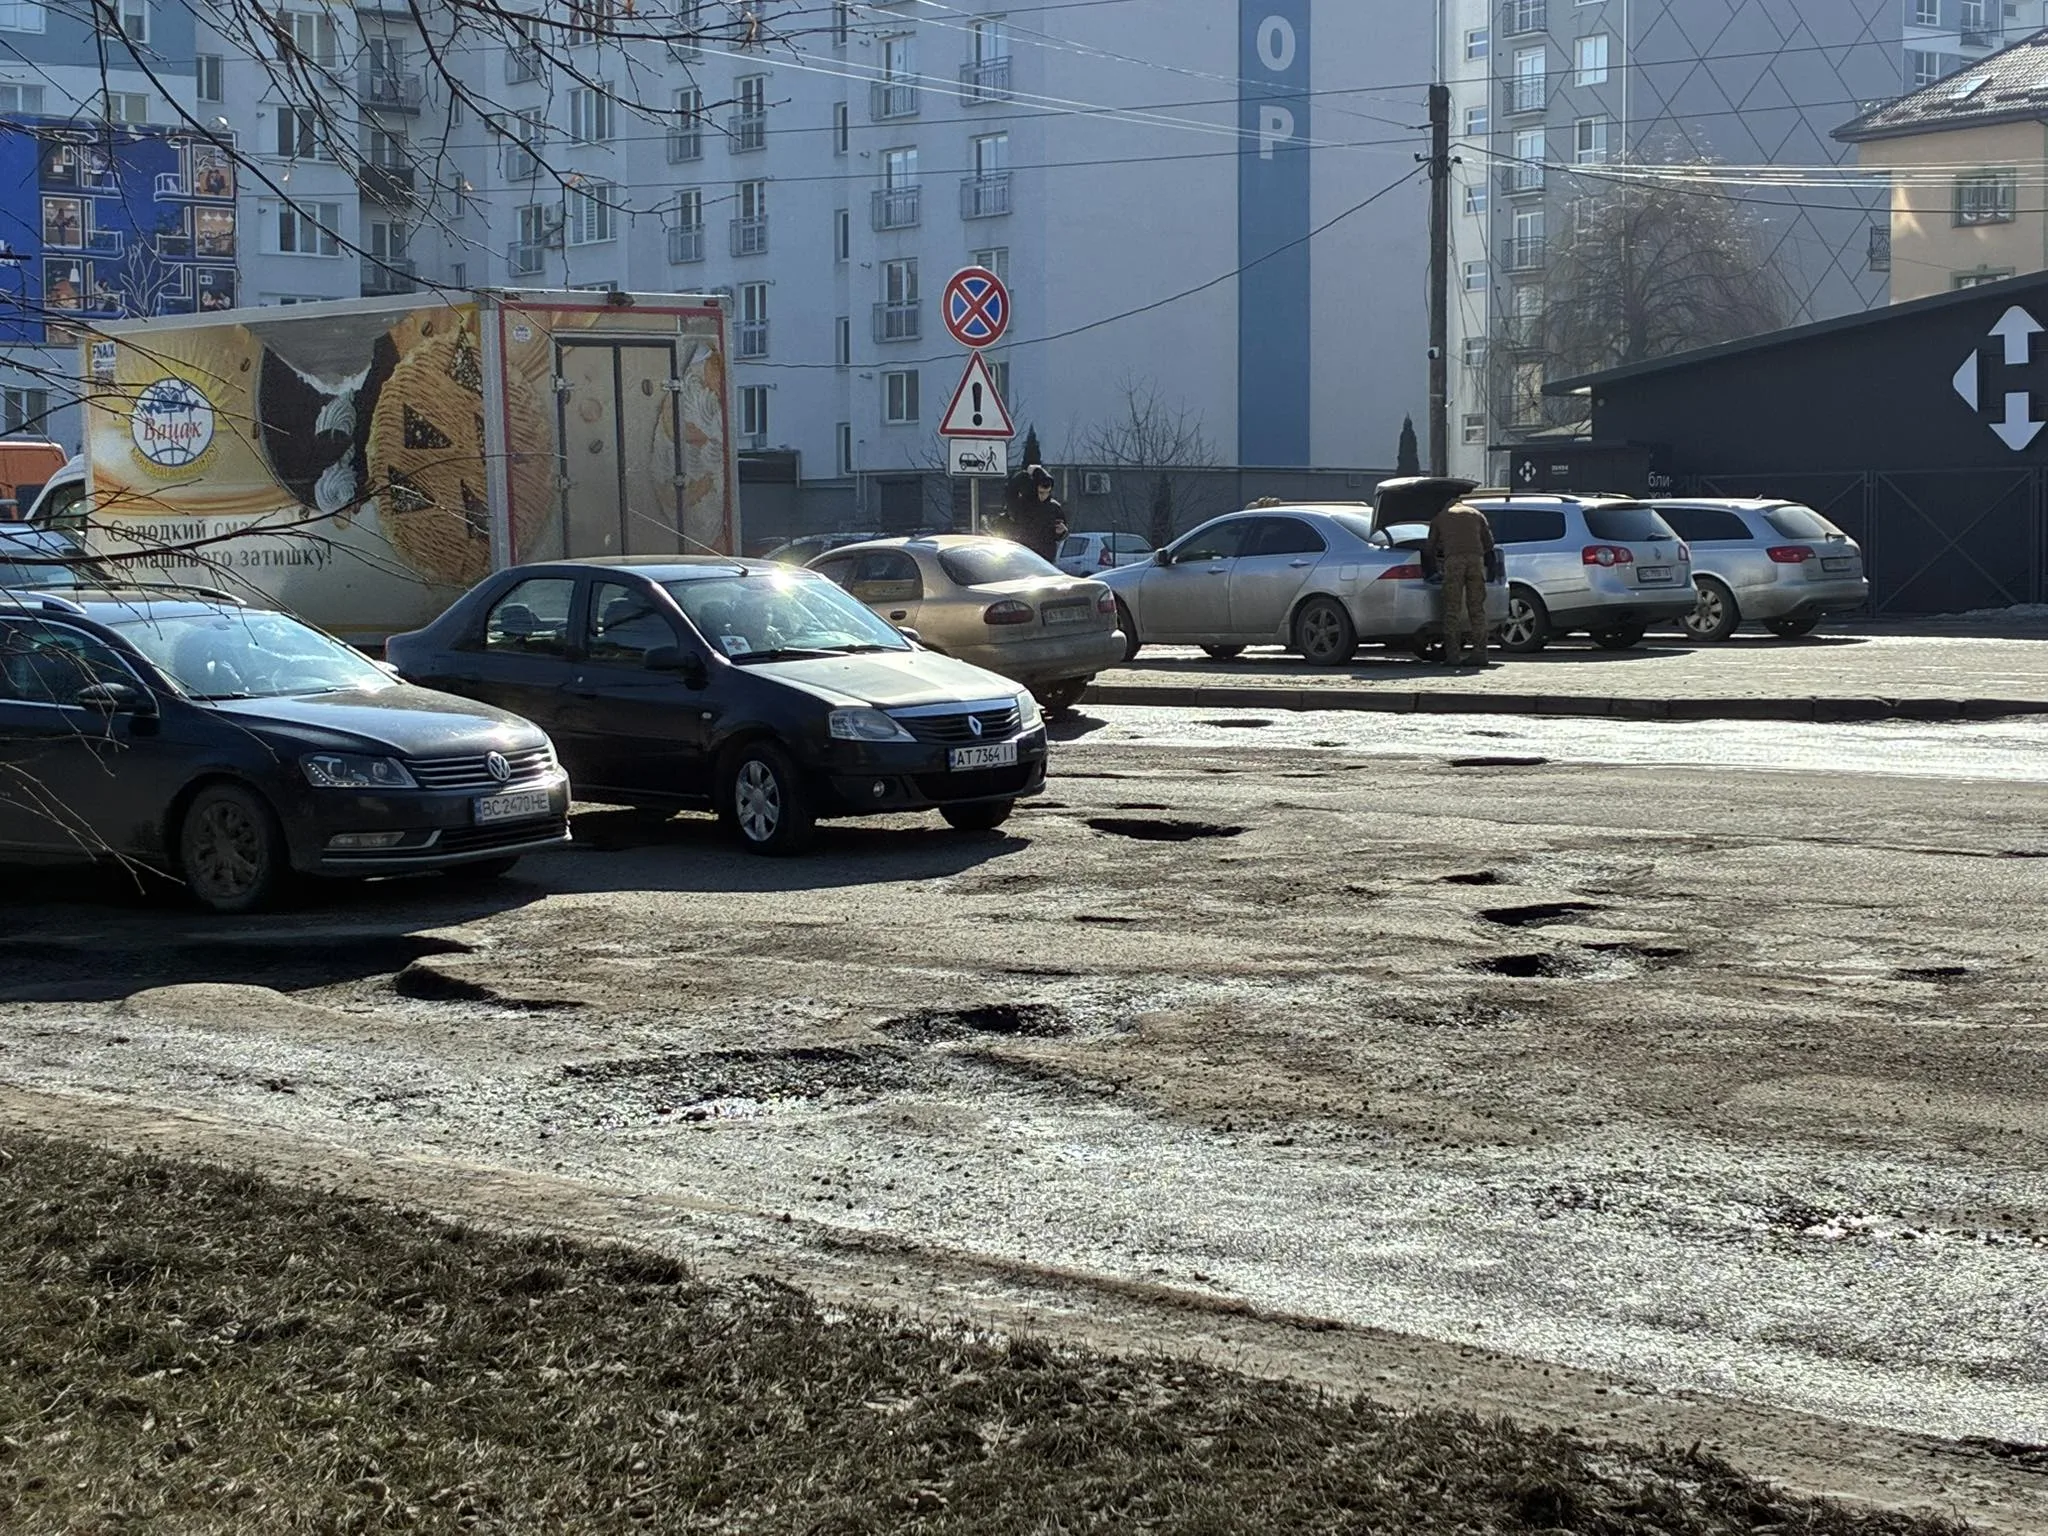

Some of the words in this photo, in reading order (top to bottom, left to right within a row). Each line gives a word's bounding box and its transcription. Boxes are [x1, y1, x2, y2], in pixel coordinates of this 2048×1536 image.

[143, 417, 203, 445] Вацак
[109, 519, 207, 543] Солодкий
[240, 547, 333, 571] затишку!
[956, 749, 973, 766] AT
[976, 746, 1000, 763] 7364
[482, 800, 500, 817] BC
